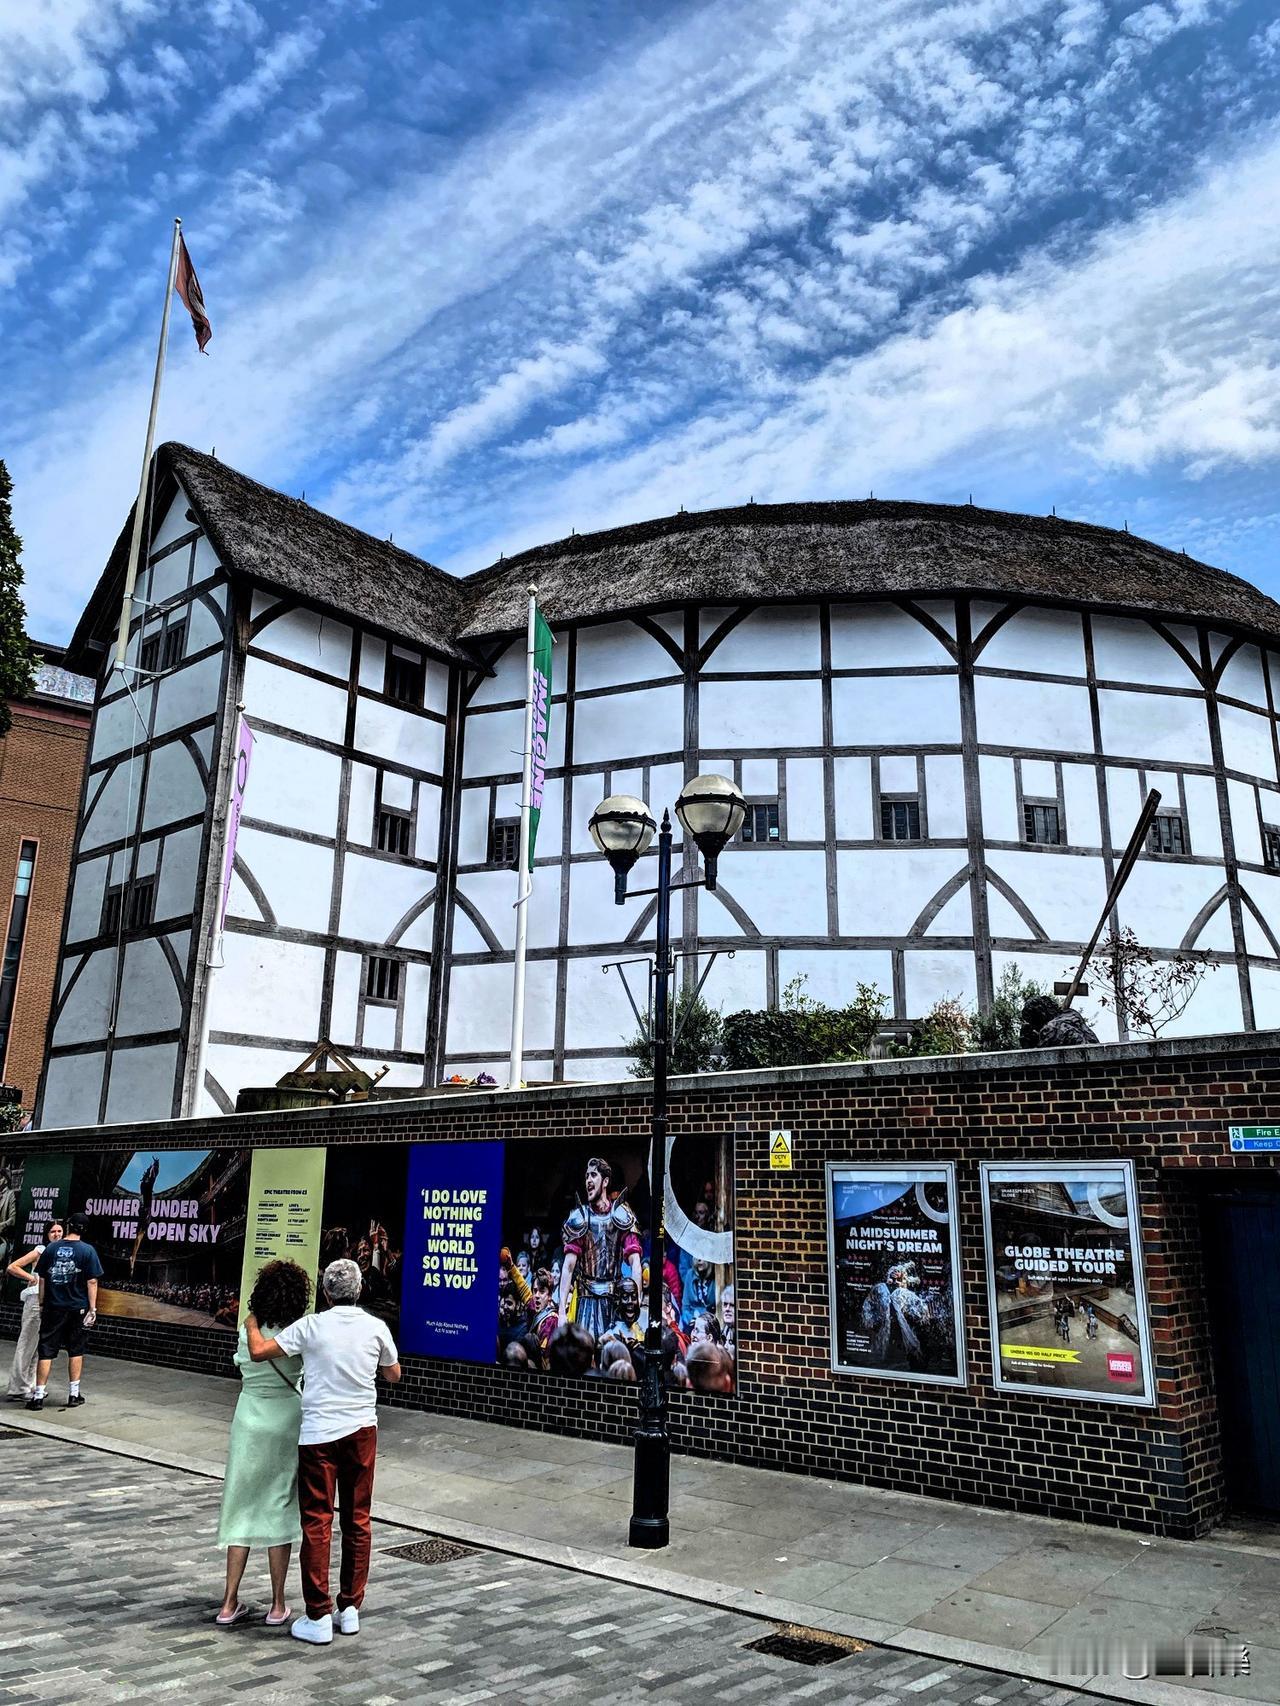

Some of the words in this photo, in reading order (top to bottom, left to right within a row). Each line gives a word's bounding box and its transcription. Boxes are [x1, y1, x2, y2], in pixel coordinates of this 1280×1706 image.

[534, 672, 548, 809] IMAGINE
[1274, 1128, 1280, 1136] E
[1253, 1140, 1273, 1148] Keep
[48, 1187, 60, 1197] ME
[431, 1189, 450, 1204] DO
[452, 1190, 487, 1204] LOVE
[33, 1199, 53, 1210] YOUR
[85, 1198, 141, 1217] SUMMER
[150, 1199, 199, 1218] UNDER
[423, 1206, 482, 1221] NOTHING
[25, 1223, 33, 1233] IF
[33, 1223, 45, 1233] WE
[112, 1221, 139, 1239] THE
[147, 1222, 186, 1242] OPEN
[187, 1224, 221, 1244] SKY
[430, 1223, 444, 1236] IN
[447, 1223, 473, 1238] THE
[849, 1226, 858, 1237] A
[860, 1227, 938, 1241] MIDSUMMER
[22, 1234, 44, 1245] FRIEN
[427, 1239, 475, 1255] WORLD
[897, 1241, 943, 1253] DREAM
[1004, 1245, 1051, 1259] GLOBE
[1054, 1247, 1125, 1262] THEATRE
[422, 1255, 440, 1270] SO
[442, 1256, 478, 1272] WELL
[1014, 1258, 1069, 1273] GUIDED
[1072, 1260, 1117, 1275] TOUR
[423, 1273, 441, 1287] AS
[453, 1323, 469, 1331] Nothing
